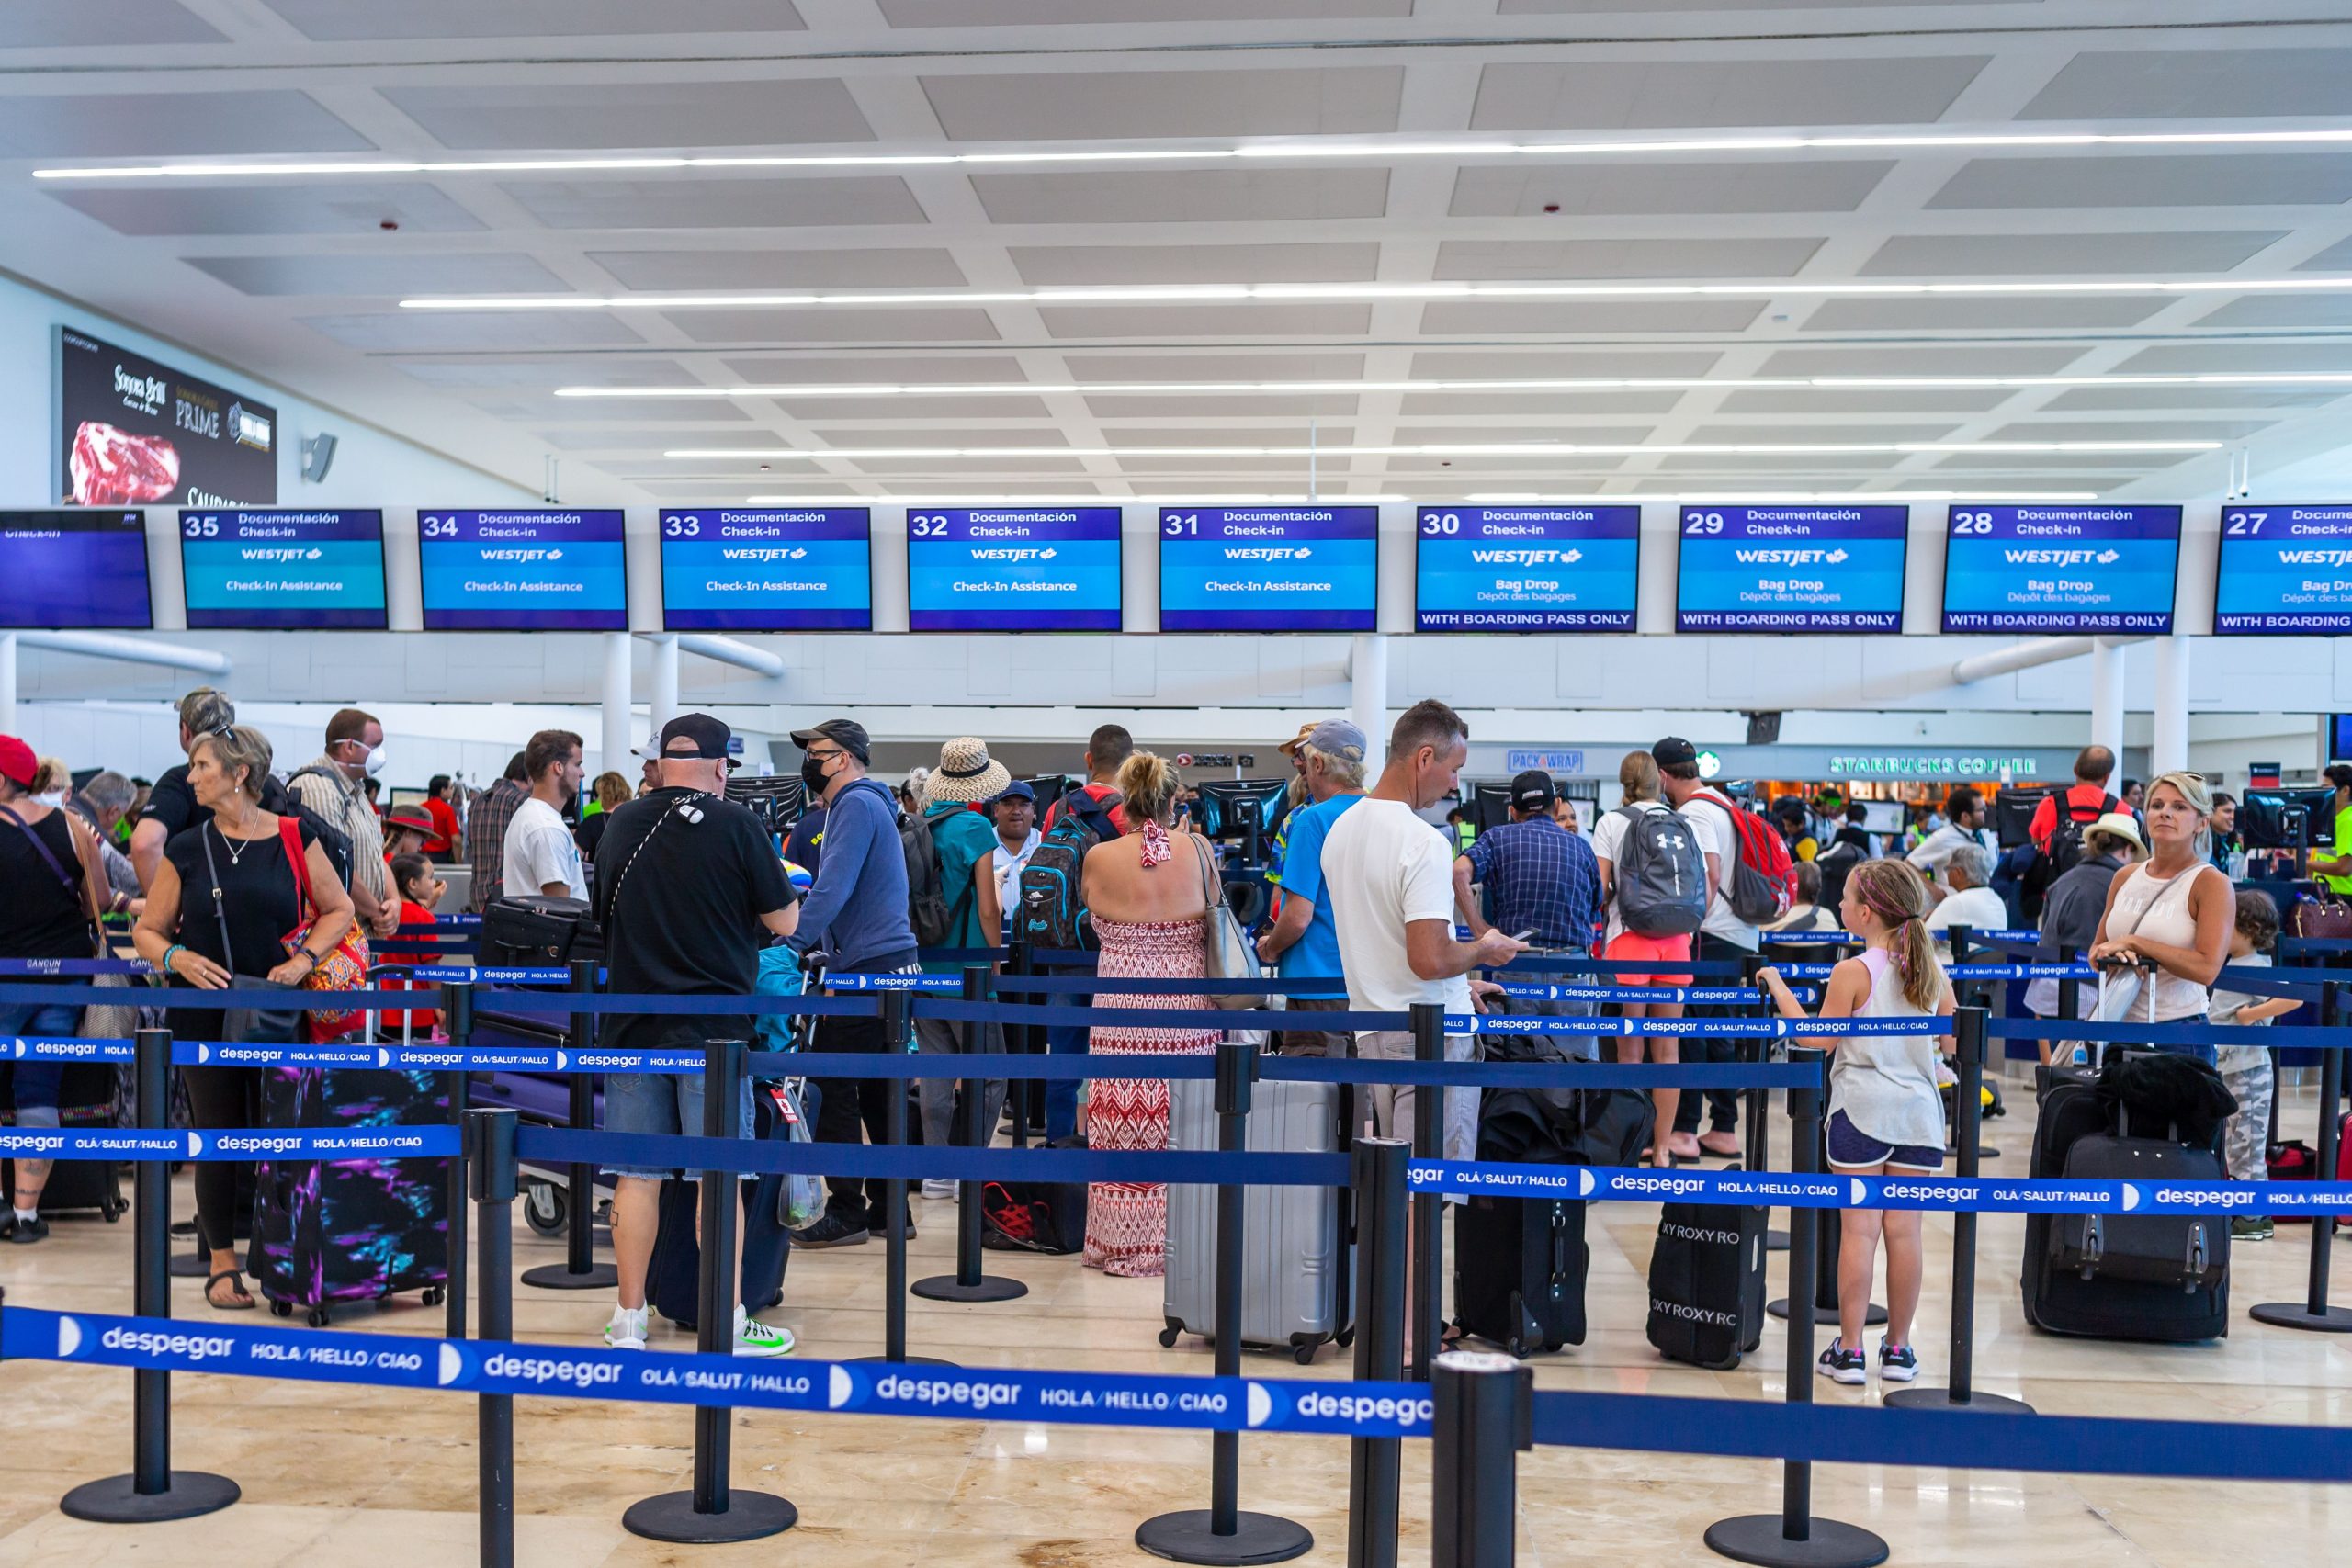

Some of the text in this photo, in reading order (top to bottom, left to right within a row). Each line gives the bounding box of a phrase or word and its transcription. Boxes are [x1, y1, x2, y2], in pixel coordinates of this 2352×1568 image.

[175, 399, 220, 439] PRIME
[239, 513, 339, 524] Documentación
[479, 513, 580, 524] Documentación
[721, 513, 825, 522] Documentación
[970, 512, 1076, 522] Documentación
[1224, 512, 1331, 521] Documentación
[1483, 511, 1593, 520] Documentación
[1747, 510, 1860, 520] Documentación
[2018, 510, 2132, 520] Documentación
[186, 517, 218, 536] 35
[424, 517, 458, 536] 34
[666, 516, 699, 536] 33
[913, 516, 947, 536] 32
[1166, 515, 1197, 535] 31
[1423, 514, 1459, 534] 30
[1686, 513, 1723, 534] 29
[1954, 513, 1992, 533] 28
[2228, 513, 2267, 534] 27
[239, 527, 295, 536] Check-in
[479, 527, 536, 536] Check-in
[722, 526, 780, 536] Check-in
[970, 526, 1029, 536] Check-in
[1224, 525, 1283, 535] Check-in
[1483, 525, 1544, 535] Check-in
[1747, 525, 1810, 534] Check-in
[2017, 525, 2081, 534] Check-in
[242, 549, 305, 562] WESTJET
[481, 550, 546, 562] WESTJET
[723, 549, 789, 561] WESTJET
[971, 549, 1039, 562] WESTJET
[1225, 548, 1294, 561] WESTJET
[1473, 550, 1559, 567] WESTJET
[1736, 550, 1825, 567] WESTJET
[2005, 550, 2096, 567] WESTJET
[226, 581, 342, 590] Check-In Assistance
[465, 581, 582, 591] Check-In Assistance
[707, 581, 827, 591] Check-In Assistance
[954, 581, 1077, 591] Check-In Assistance
[1205, 581, 1331, 591] Check-In Assistance
[1495, 579, 1558, 592] Bag Drop
[1758, 579, 1823, 592] Bag Drop
[2028, 580, 2093, 592] Bag Drop
[2302, 580, 2352, 593] Bag Dr
[1477, 592, 1576, 604] Dépôt des bagages
[1740, 592, 1841, 604] Dépôt des bagages
[2007, 592, 2110, 604] Dépôt des bagages
[2282, 593, 2314, 604] Dépôt
[2318, 593, 2337, 603] des
[1422, 615, 1630, 625] WITH BOARDING PASS ONLY
[1683, 615, 1894, 625] WITH BOARDING PASS ONLY
[1950, 615, 2166, 626] WITH BOARDING PASS ONLY
[2222, 616, 2350, 626] WITH BOARDING
[1830, 757, 1954, 774] STARBUCKS
[484, 971, 526, 979] despegar
[874, 978, 917, 989] despegar
[1566, 988, 1611, 998] despegar
[1692, 991, 1737, 1000] despegar
[1488, 1020, 1542, 1031] despegar
[1643, 1021, 1697, 1032] despegar
[1796, 1022, 1850, 1032] despegar
[36, 1043, 96, 1056] despegar
[220, 1048, 282, 1062] despegar
[291, 1053, 370, 1061] HOLA/HELLO/CIAO
[401, 1052, 463, 1065] despegar
[472, 1055, 548, 1064] OLÁ/SALUT/HALLO
[579, 1055, 642, 1067] despegar
[75, 1138, 177, 1149] OLÁ/SALUT/HALLO
[217, 1136, 301, 1153] despegar
[313, 1137, 422, 1148] HOLA/HELLO/CIAO
[1457, 1171, 1567, 1186] OLÁ/SALUT/HALLO
[1611, 1175, 1705, 1194] despegar
[1718, 1183, 1838, 1195] HOLA/HELLO/CIAO
[1883, 1183, 1980, 1202] despegar
[1993, 1189, 2110, 1201] OLÁ/SALUT/HALLO
[2156, 1189, 2256, 1208] despegar
[1677, 1225, 1714, 1242] ROXY
[1672, 1305, 1715, 1323] ROXY
[102, 1327, 234, 1360] despegar
[251, 1344, 422, 1370] HOLA/HELLO/CIAO
[484, 1354, 622, 1387] despegar
[641, 1366, 810, 1393] OLÁ/SALUT/HALLO
[877, 1375, 1021, 1409] despegar
[1041, 1389, 1227, 1412] HOLA/HELLO/CIAO
